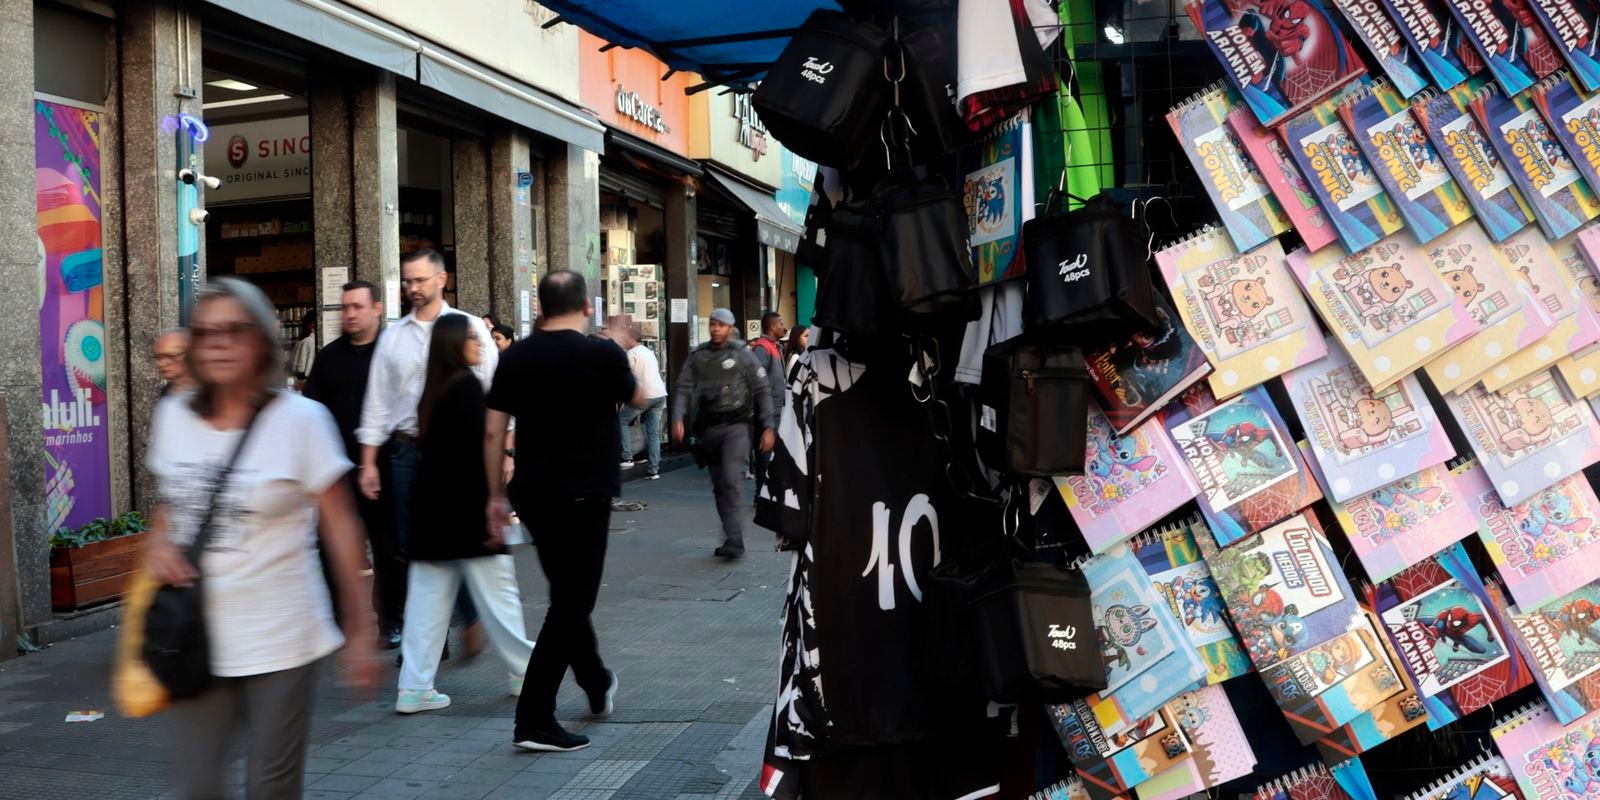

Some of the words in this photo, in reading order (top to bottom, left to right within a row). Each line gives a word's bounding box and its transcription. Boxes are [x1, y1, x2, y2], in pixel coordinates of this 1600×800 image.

[1362, 0, 1400, 45] OMEM
[1389, 0, 1430, 52] RANHA
[1408, 0, 1441, 39] MEM
[1469, 0, 1509, 44] OMEM
[1538, 0, 1578, 53] RANHA
[1557, 0, 1589, 38] MEM
[1206, 30, 1252, 89] ARANHA
[1225, 24, 1266, 75] HOMEM
[800, 69, 826, 84] 48pcs
[1196, 141, 1240, 203] SONIC
[1302, 142, 1348, 203] SONIC
[1319, 141, 1343, 174] COLORINDO
[1338, 173, 1350, 188] COM
[1371, 131, 1416, 193] SONIC
[1385, 130, 1409, 164] COLORINDO
[1406, 162, 1418, 178] COM
[1444, 130, 1489, 192] SONIC
[1459, 129, 1483, 162] COLORINDO
[1480, 161, 1492, 176] COM
[1504, 128, 1550, 190] SONIC
[1519, 127, 1542, 161] COLORINDO
[1540, 160, 1552, 174] COM
[1565, 117, 1600, 178] SONI
[226, 171, 279, 183] ORIGINAL
[1064, 268, 1090, 283] 48pcs
[43, 431, 94, 447] marinhos
[1194, 436, 1229, 489] HOMEM
[1067, 476, 1097, 510] TCH
[1176, 440, 1217, 503] ARANHA
[1345, 498, 1379, 538] TCH
[1480, 501, 1528, 568] STITCH
[862, 493, 941, 611] 10
[1284, 528, 1332, 597] COLORINDO
[1051, 639, 1077, 651] 48pcs
[1387, 624, 1428, 686] ARANHA
[1405, 620, 1440, 673] HOMEM
[1512, 619, 1555, 681] ARANHA
[1530, 615, 1567, 667] HOMEM
[1289, 658, 1318, 694] RINDO
[1525, 761, 1562, 800] STIT
